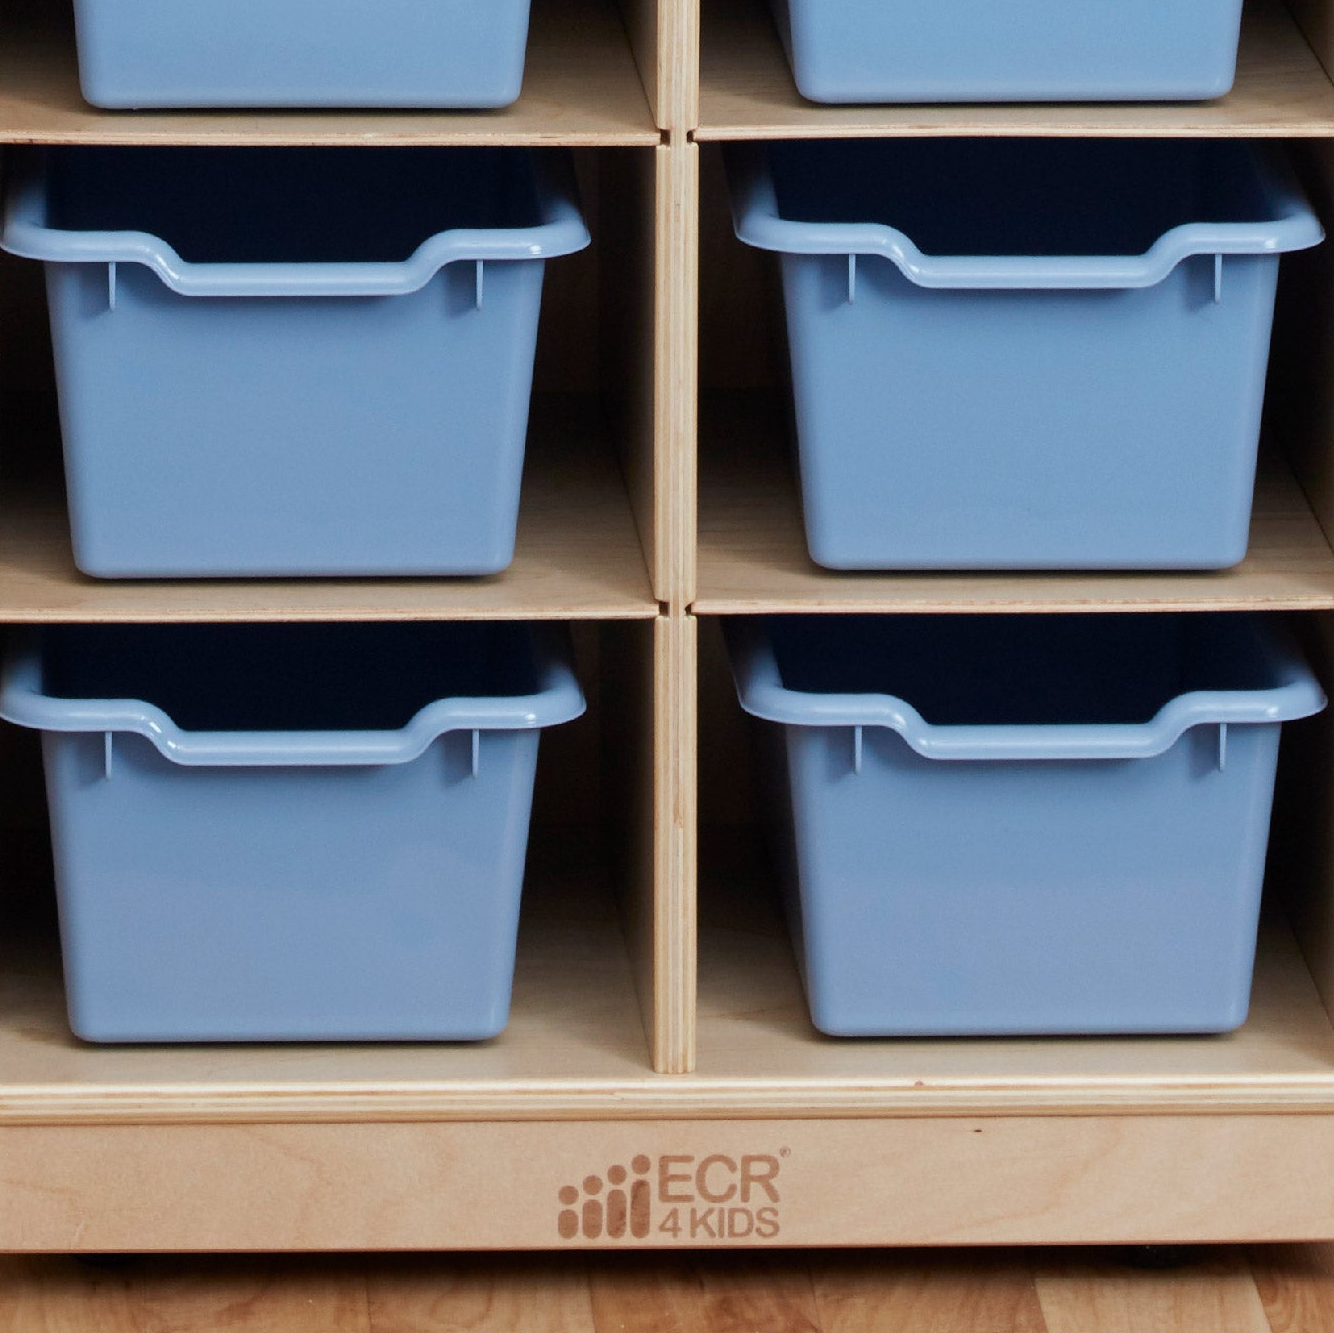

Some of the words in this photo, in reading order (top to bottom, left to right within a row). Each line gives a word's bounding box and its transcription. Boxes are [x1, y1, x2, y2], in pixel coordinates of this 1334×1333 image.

[658, 1153, 780, 1204] ECR
[658, 1207, 683, 1238] 4
[690, 1206, 781, 1239] KIDS
